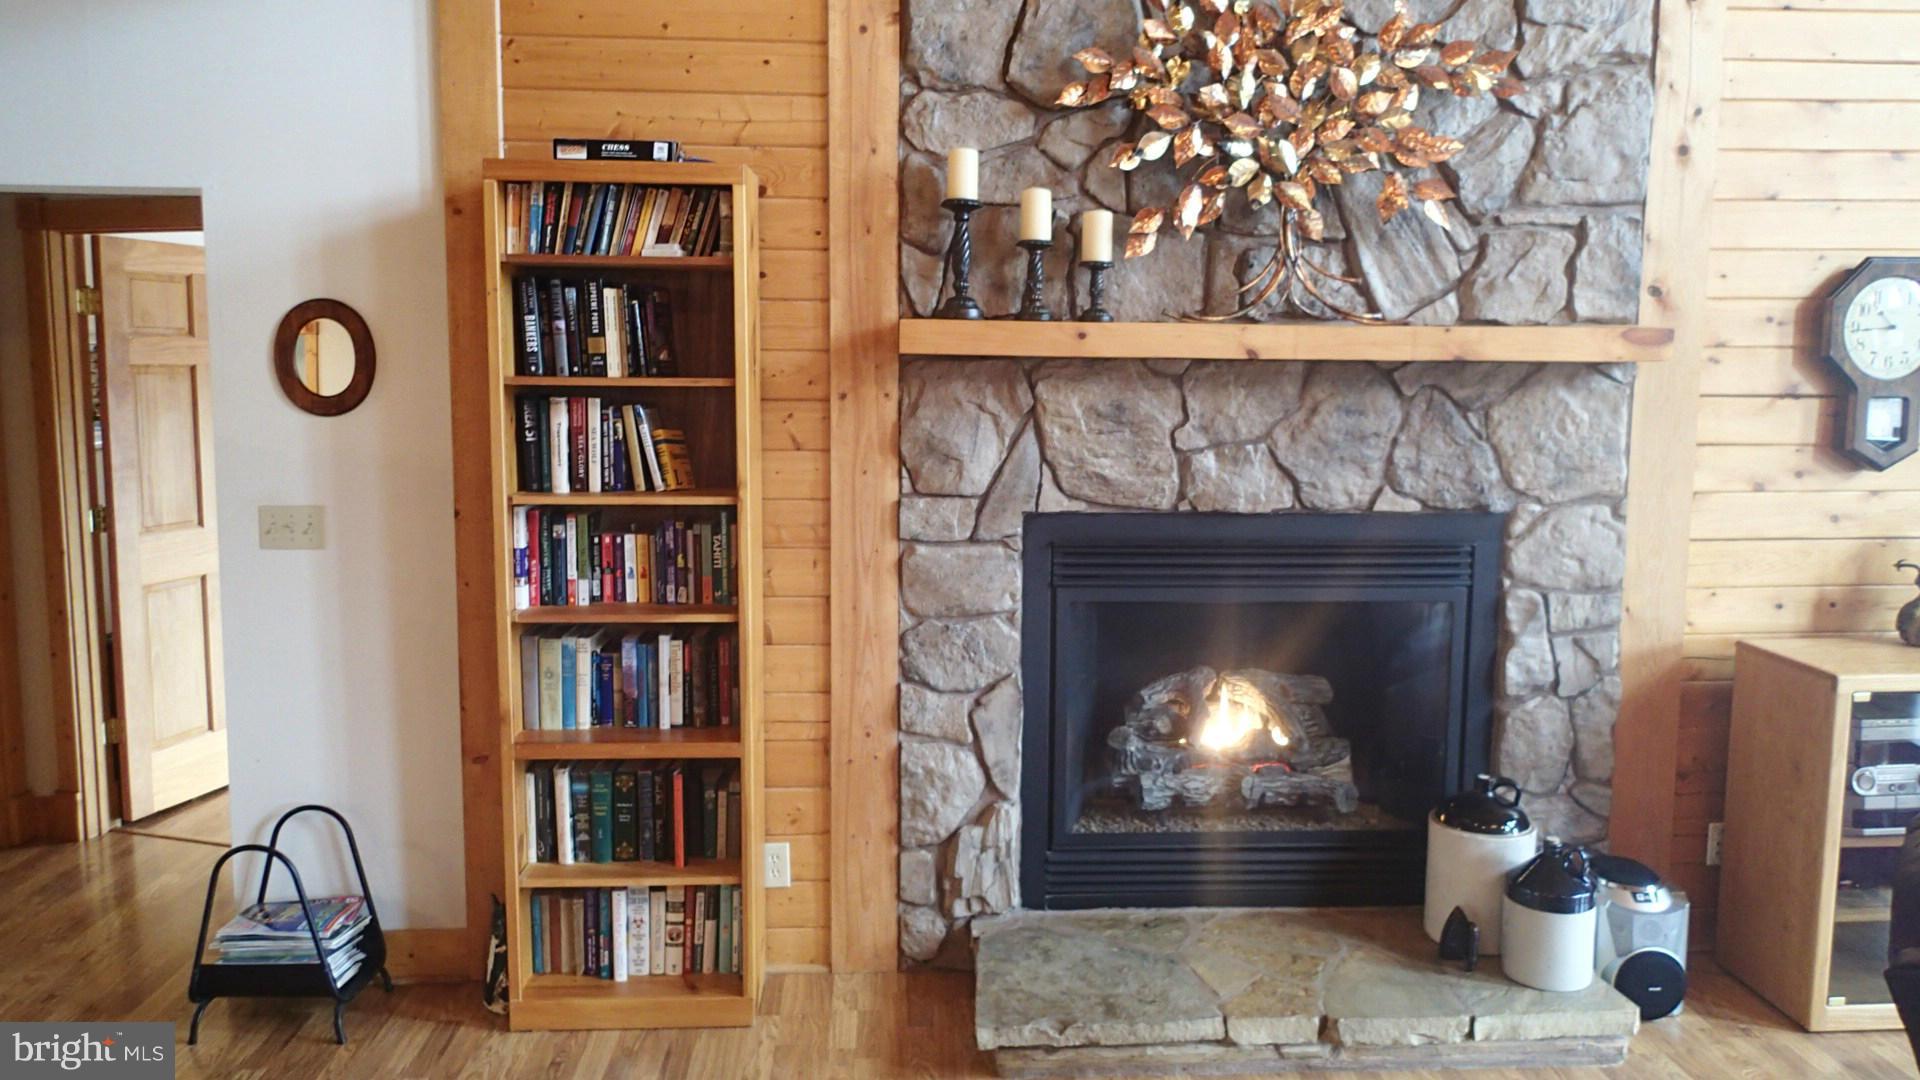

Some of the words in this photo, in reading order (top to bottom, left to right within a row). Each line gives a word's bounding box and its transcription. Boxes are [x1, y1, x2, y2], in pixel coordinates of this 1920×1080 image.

[601, 143, 630, 151] CHESS
[589, 281, 598, 311] SUPREME
[524, 314, 538, 353] BANKERS
[591, 312, 600, 334] POWER
[712, 534, 721, 568] TAHITI
